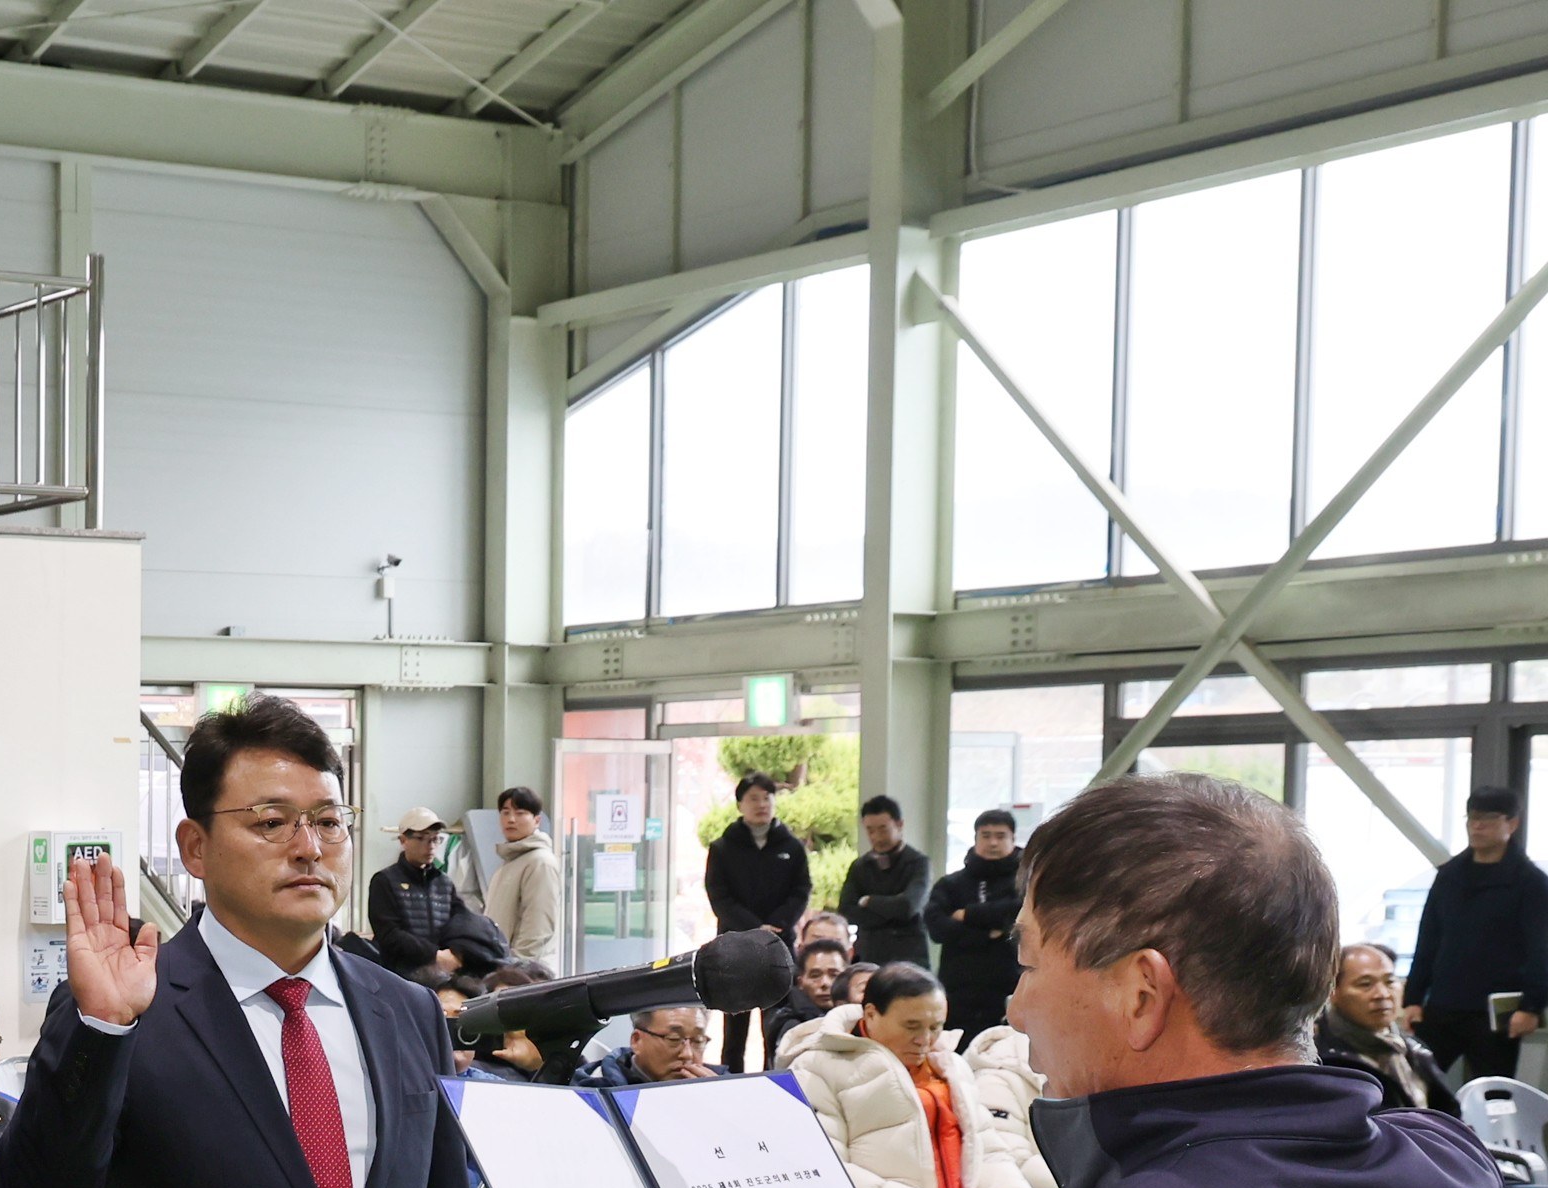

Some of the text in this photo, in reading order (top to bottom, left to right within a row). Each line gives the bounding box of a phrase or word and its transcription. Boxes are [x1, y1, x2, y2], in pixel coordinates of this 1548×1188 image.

[73, 846, 104, 860] AED
[746, 1173, 791, 1187] 진도군의회
[794, 1168, 821, 1180] 의장배
